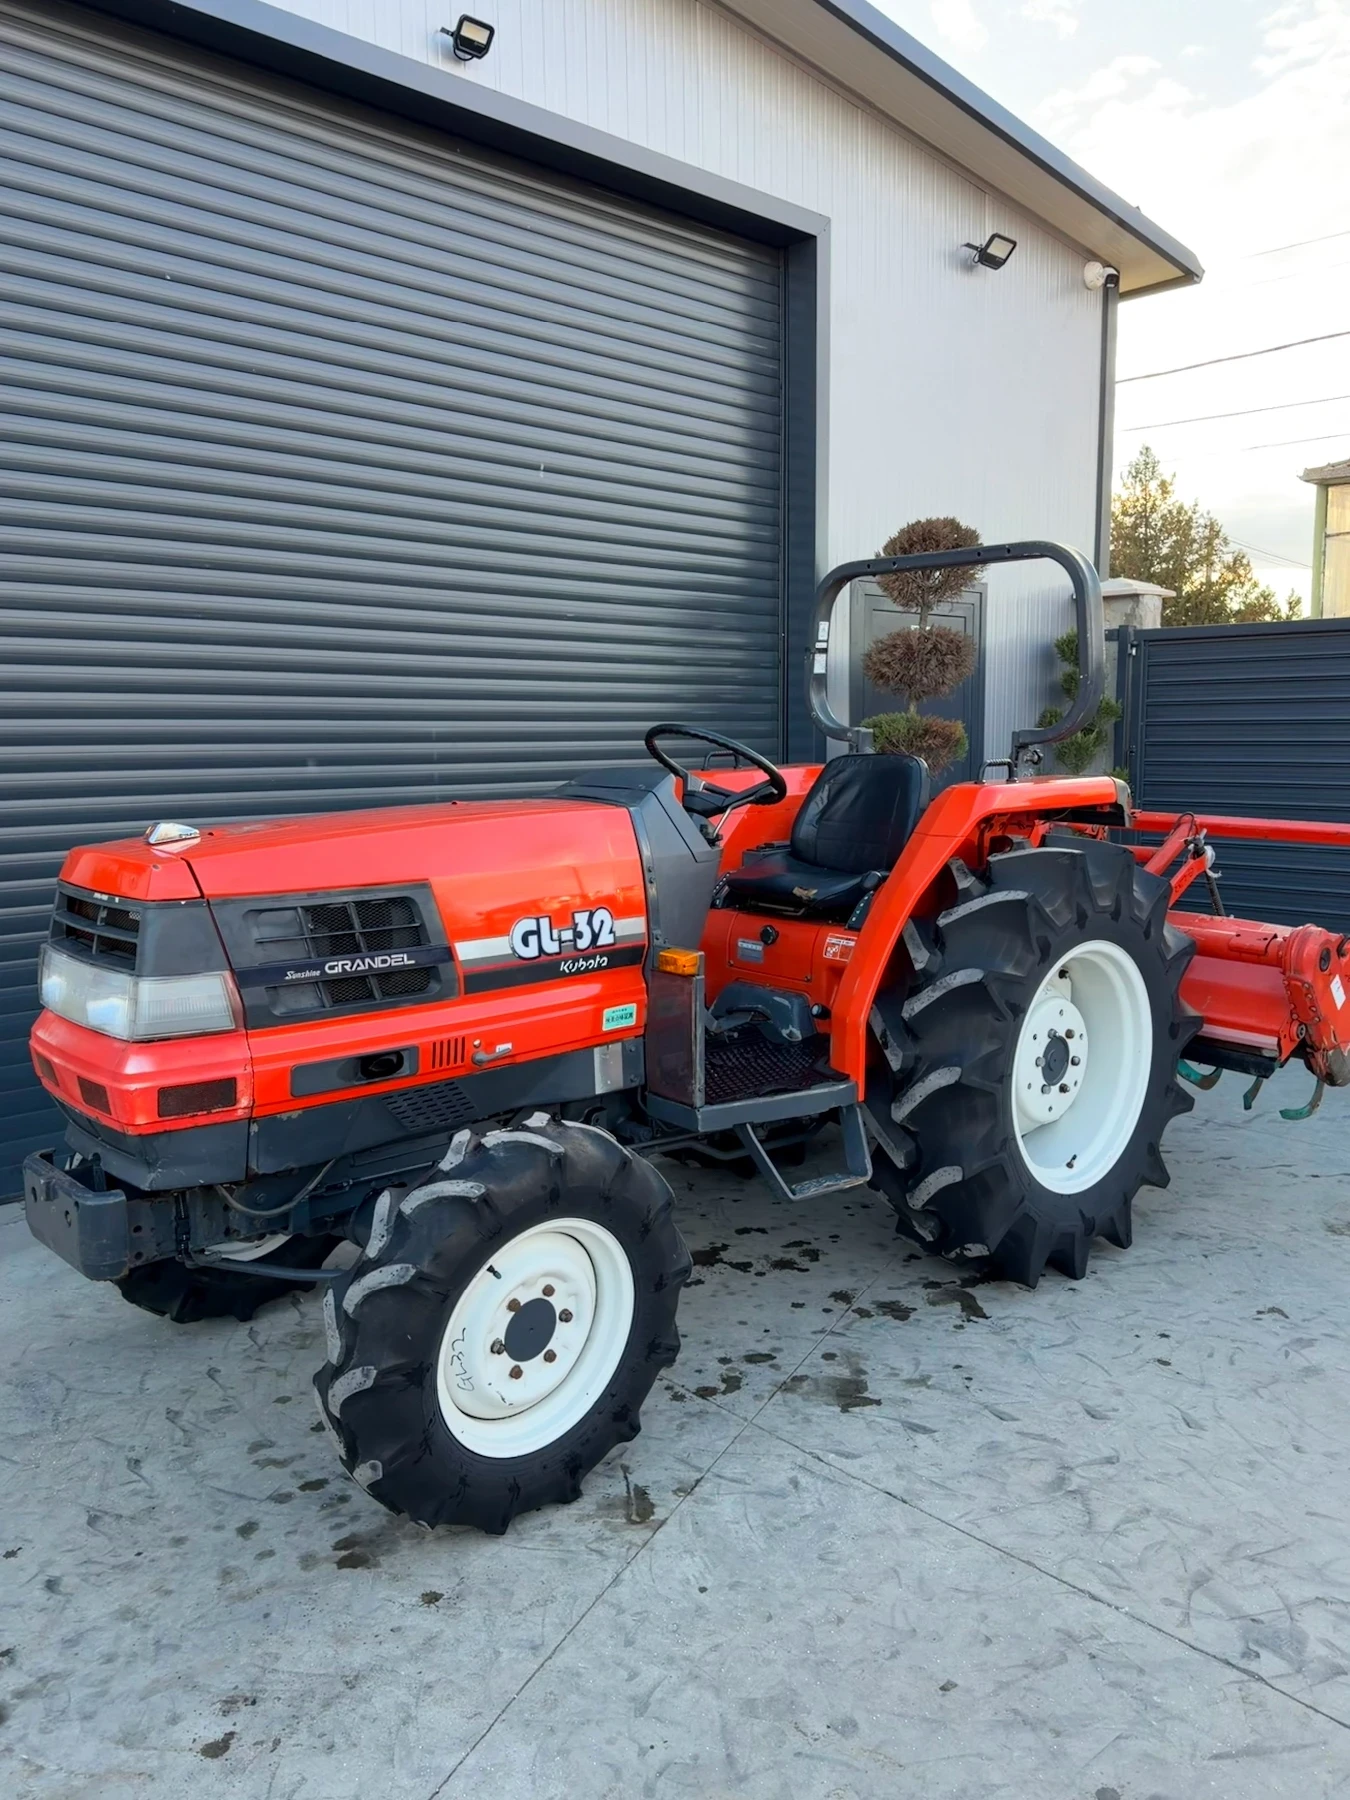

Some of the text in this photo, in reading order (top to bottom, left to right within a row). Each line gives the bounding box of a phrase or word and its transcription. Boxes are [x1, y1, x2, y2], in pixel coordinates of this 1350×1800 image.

[510, 907, 616, 960] GL-32
[284, 953, 415, 981] Sunshine GRANDEL
[560, 955, 609, 973] Kubota
